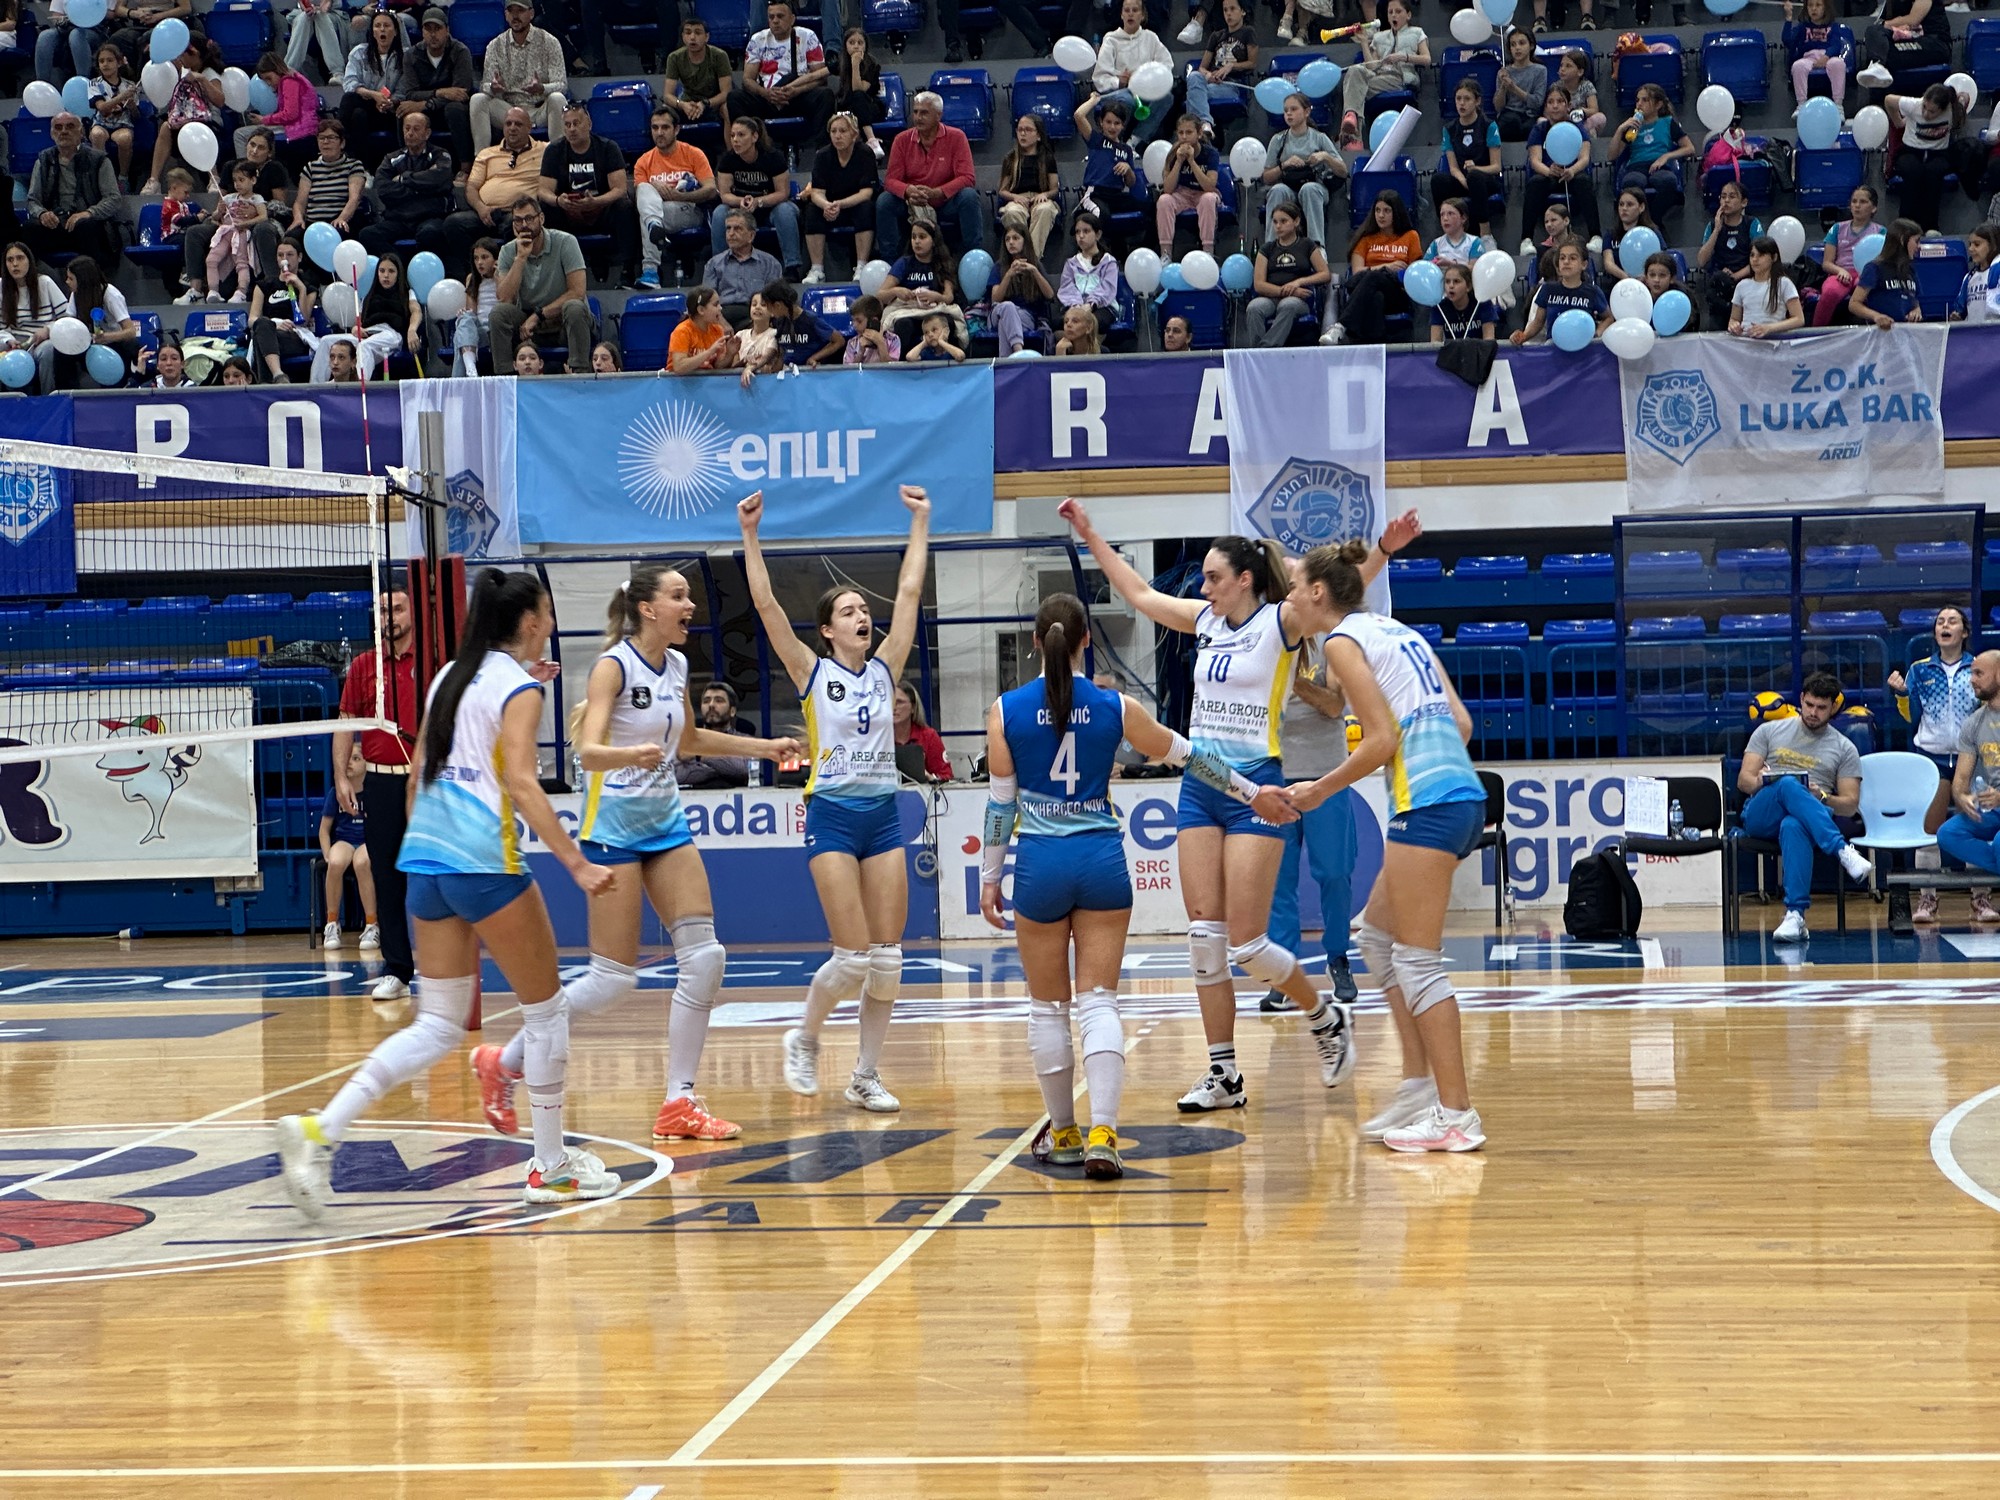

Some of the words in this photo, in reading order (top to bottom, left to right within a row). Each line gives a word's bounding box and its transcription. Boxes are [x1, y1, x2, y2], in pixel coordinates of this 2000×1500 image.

[568, 163, 594, 173] NIKE
[1391, 244, 1408, 254] BAR
[1548, 294, 1569, 305] LUKA
[1571, 296, 1589, 307] BAR
[1791, 363, 1885, 393] Ž.O.K.
[1740, 400, 1849, 432] LUKA
[1861, 392, 1934, 423] BAR
[1273, 474, 1311, 508] LUKA
[1279, 529, 1311, 554] BAR
[1207, 653, 1232, 683] 10
[1400, 640, 1443, 696] 18
[857, 705, 871, 735] 9
[1037, 704, 1090, 726] CEVIĆ
[1199, 699, 1226, 715] AREA
[1228, 702, 1269, 719] GROUP
[664, 712, 673, 743] 1
[850, 752, 875, 762] AREA
[877, 752, 897, 763] GROU
[1049, 731, 1081, 796] 4
[690, 794, 777, 836] ada
[1135, 859, 1170, 873] SRC
[1136, 878, 1171, 890] BAR
